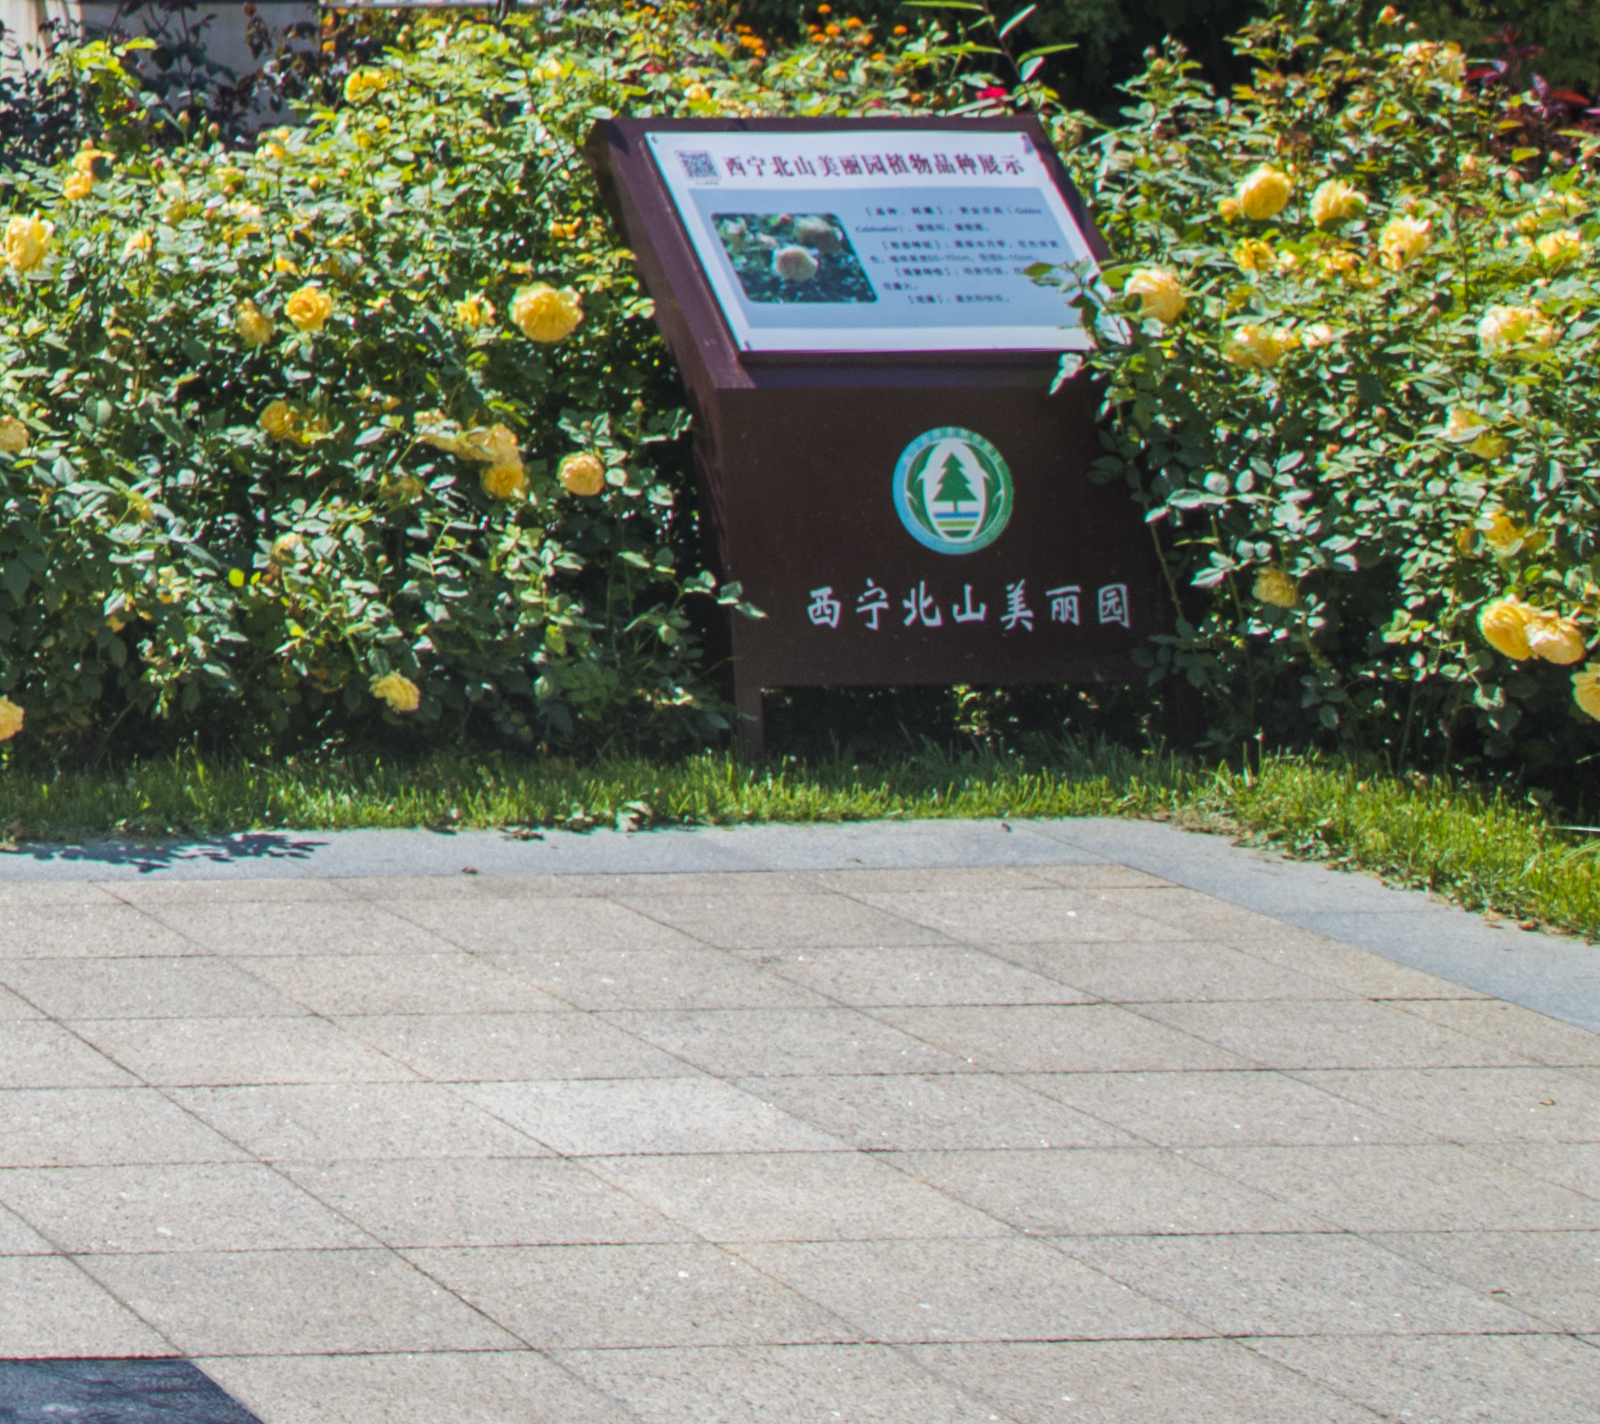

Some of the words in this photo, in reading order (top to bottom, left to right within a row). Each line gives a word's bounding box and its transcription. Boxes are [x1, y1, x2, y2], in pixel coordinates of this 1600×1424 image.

[725, 153, 1025, 177] 西宁北山美丽园植物品种展示
[807, 578, 1130, 632] 西宁北山美丽园
